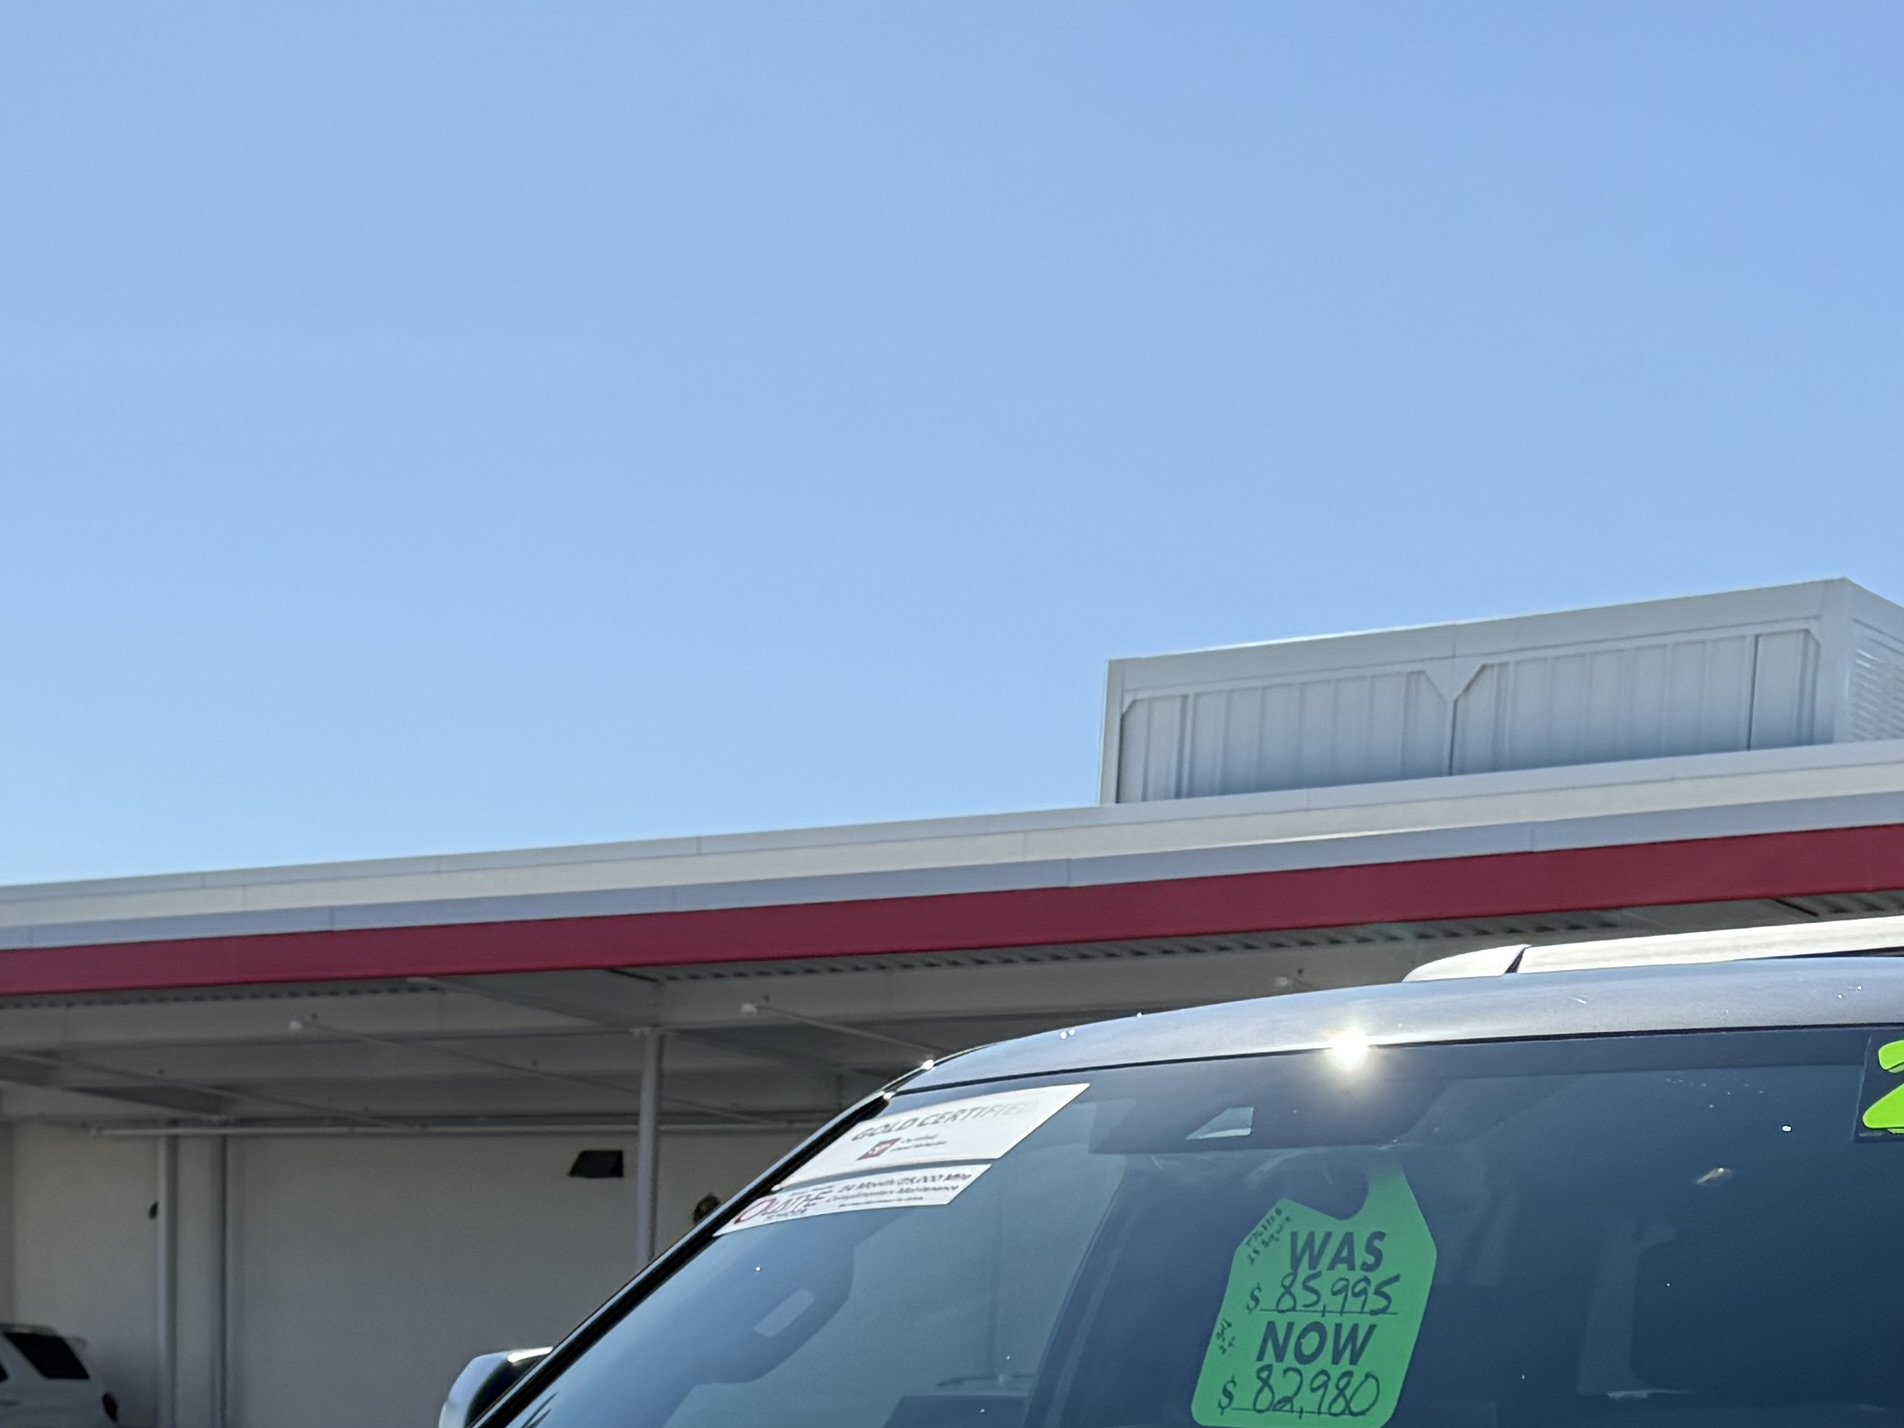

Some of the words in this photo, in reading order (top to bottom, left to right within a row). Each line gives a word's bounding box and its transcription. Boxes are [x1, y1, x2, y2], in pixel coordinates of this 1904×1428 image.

[1288, 1230, 1388, 1273] WAS
[1275, 1270, 1401, 1318] 85,995
[1256, 1320, 1378, 1366] NOW
[1252, 1363, 1381, 1421] 82,980
